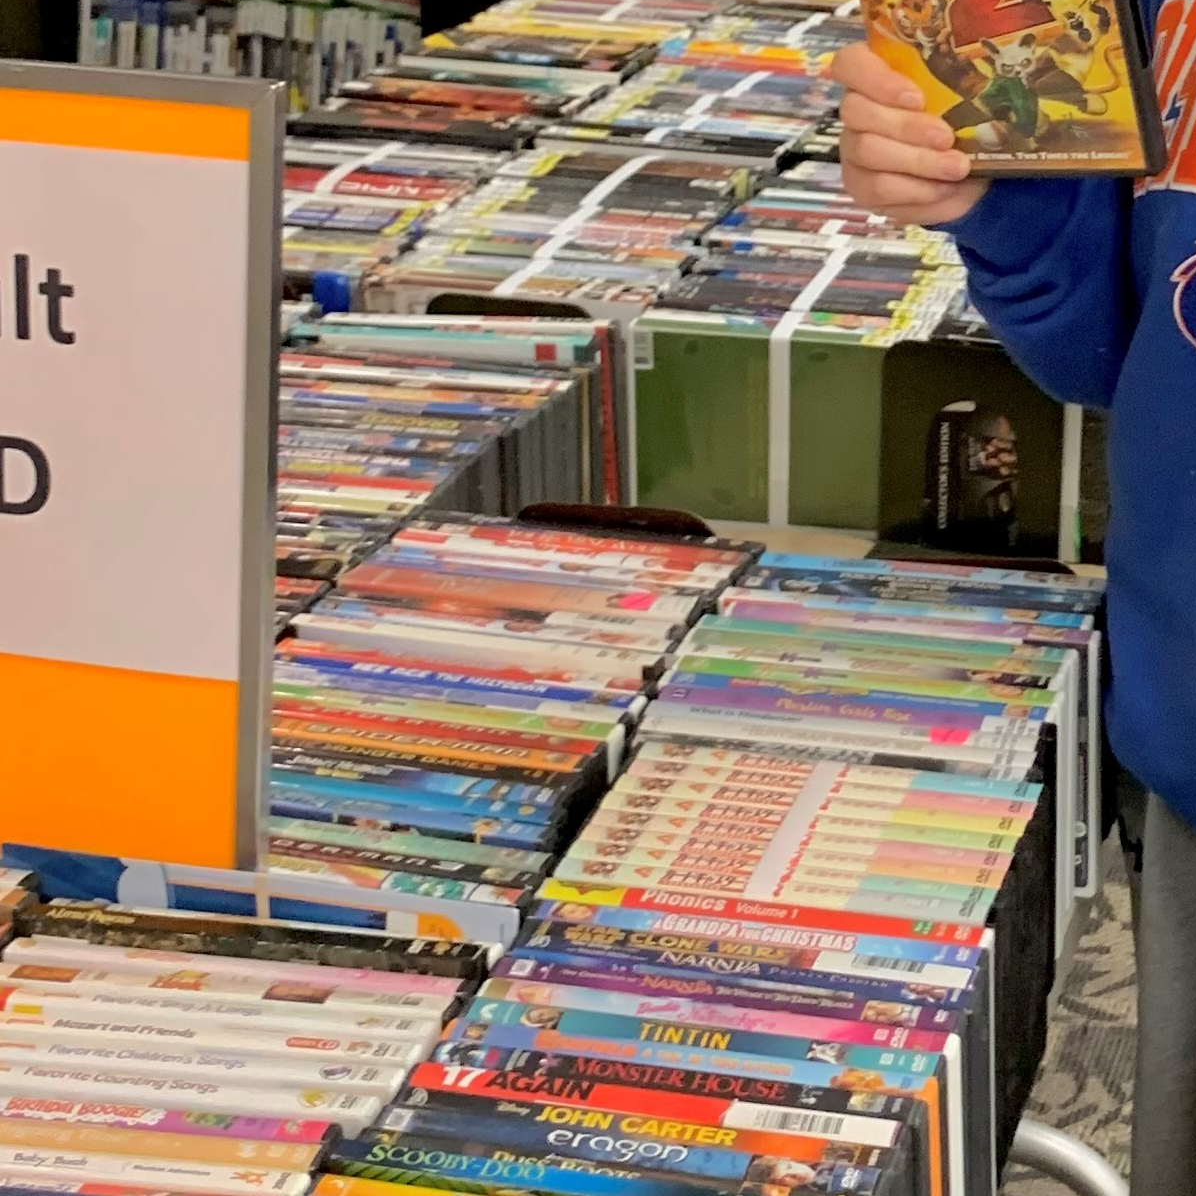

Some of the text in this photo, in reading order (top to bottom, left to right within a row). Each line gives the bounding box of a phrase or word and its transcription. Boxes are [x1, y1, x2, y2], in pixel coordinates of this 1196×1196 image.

[0, 253, 76, 345] lt
[939, 421, 950, 463] EDITION
[273, 838, 428, 867] DER-MAN
[640, 887, 799, 920] Phonics Volume 1
[629, 933, 788, 960] CLONE WARS
[662, 913, 738, 939] GRANDPA
[761, 921, 856, 951] CHRISTMAS
[657, 951, 761, 975] NARNIA
[639, 975, 714, 995] NARNIA
[53, 1019, 196, 1038] Mozart and Friends
[640, 1021, 733, 1051] TINTIN
[48, 1044, 115, 1058] Favorite
[196, 1058, 245, 1070] Songs
[23, 1066, 220, 1094] Favorite Counting Songs
[441, 1064, 596, 1101] 17 AGAIN
[571, 1057, 789, 1100] MONSTER HOUSE
[536, 1105, 615, 1130] JOHN
[620, 1114, 738, 1145] CARTER
[14, 1153, 50, 1167] Baby
[54, 1156, 89, 1166] Bach
[546, 1129, 689, 1164] eragon
[365, 1143, 546, 1183] SCOOBY-DOO
